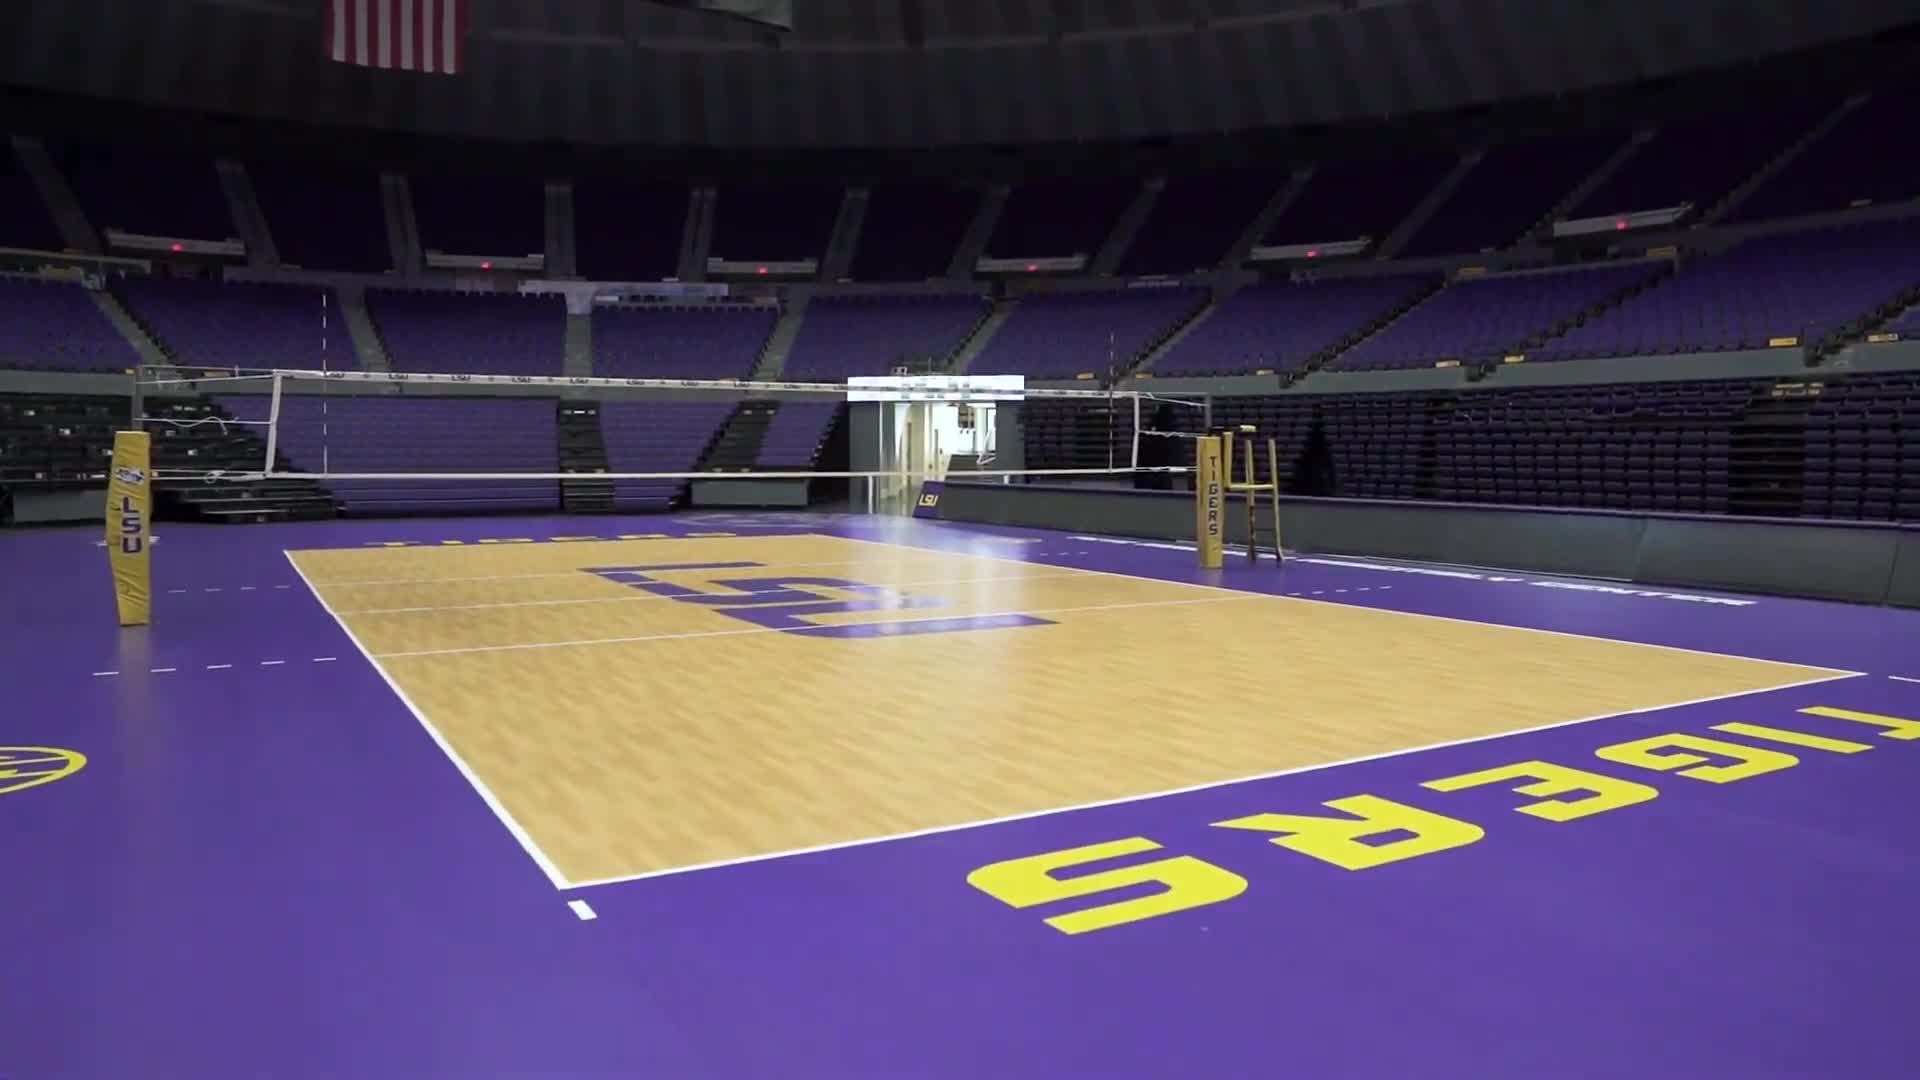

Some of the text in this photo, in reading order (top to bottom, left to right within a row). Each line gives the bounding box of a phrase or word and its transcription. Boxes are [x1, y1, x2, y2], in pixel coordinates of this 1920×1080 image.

[121, 496, 142, 553] LSU
[919, 494, 939, 506] LSU
[1208, 455, 1219, 536] TIGERS
[577, 561, 1061, 638] LSU
